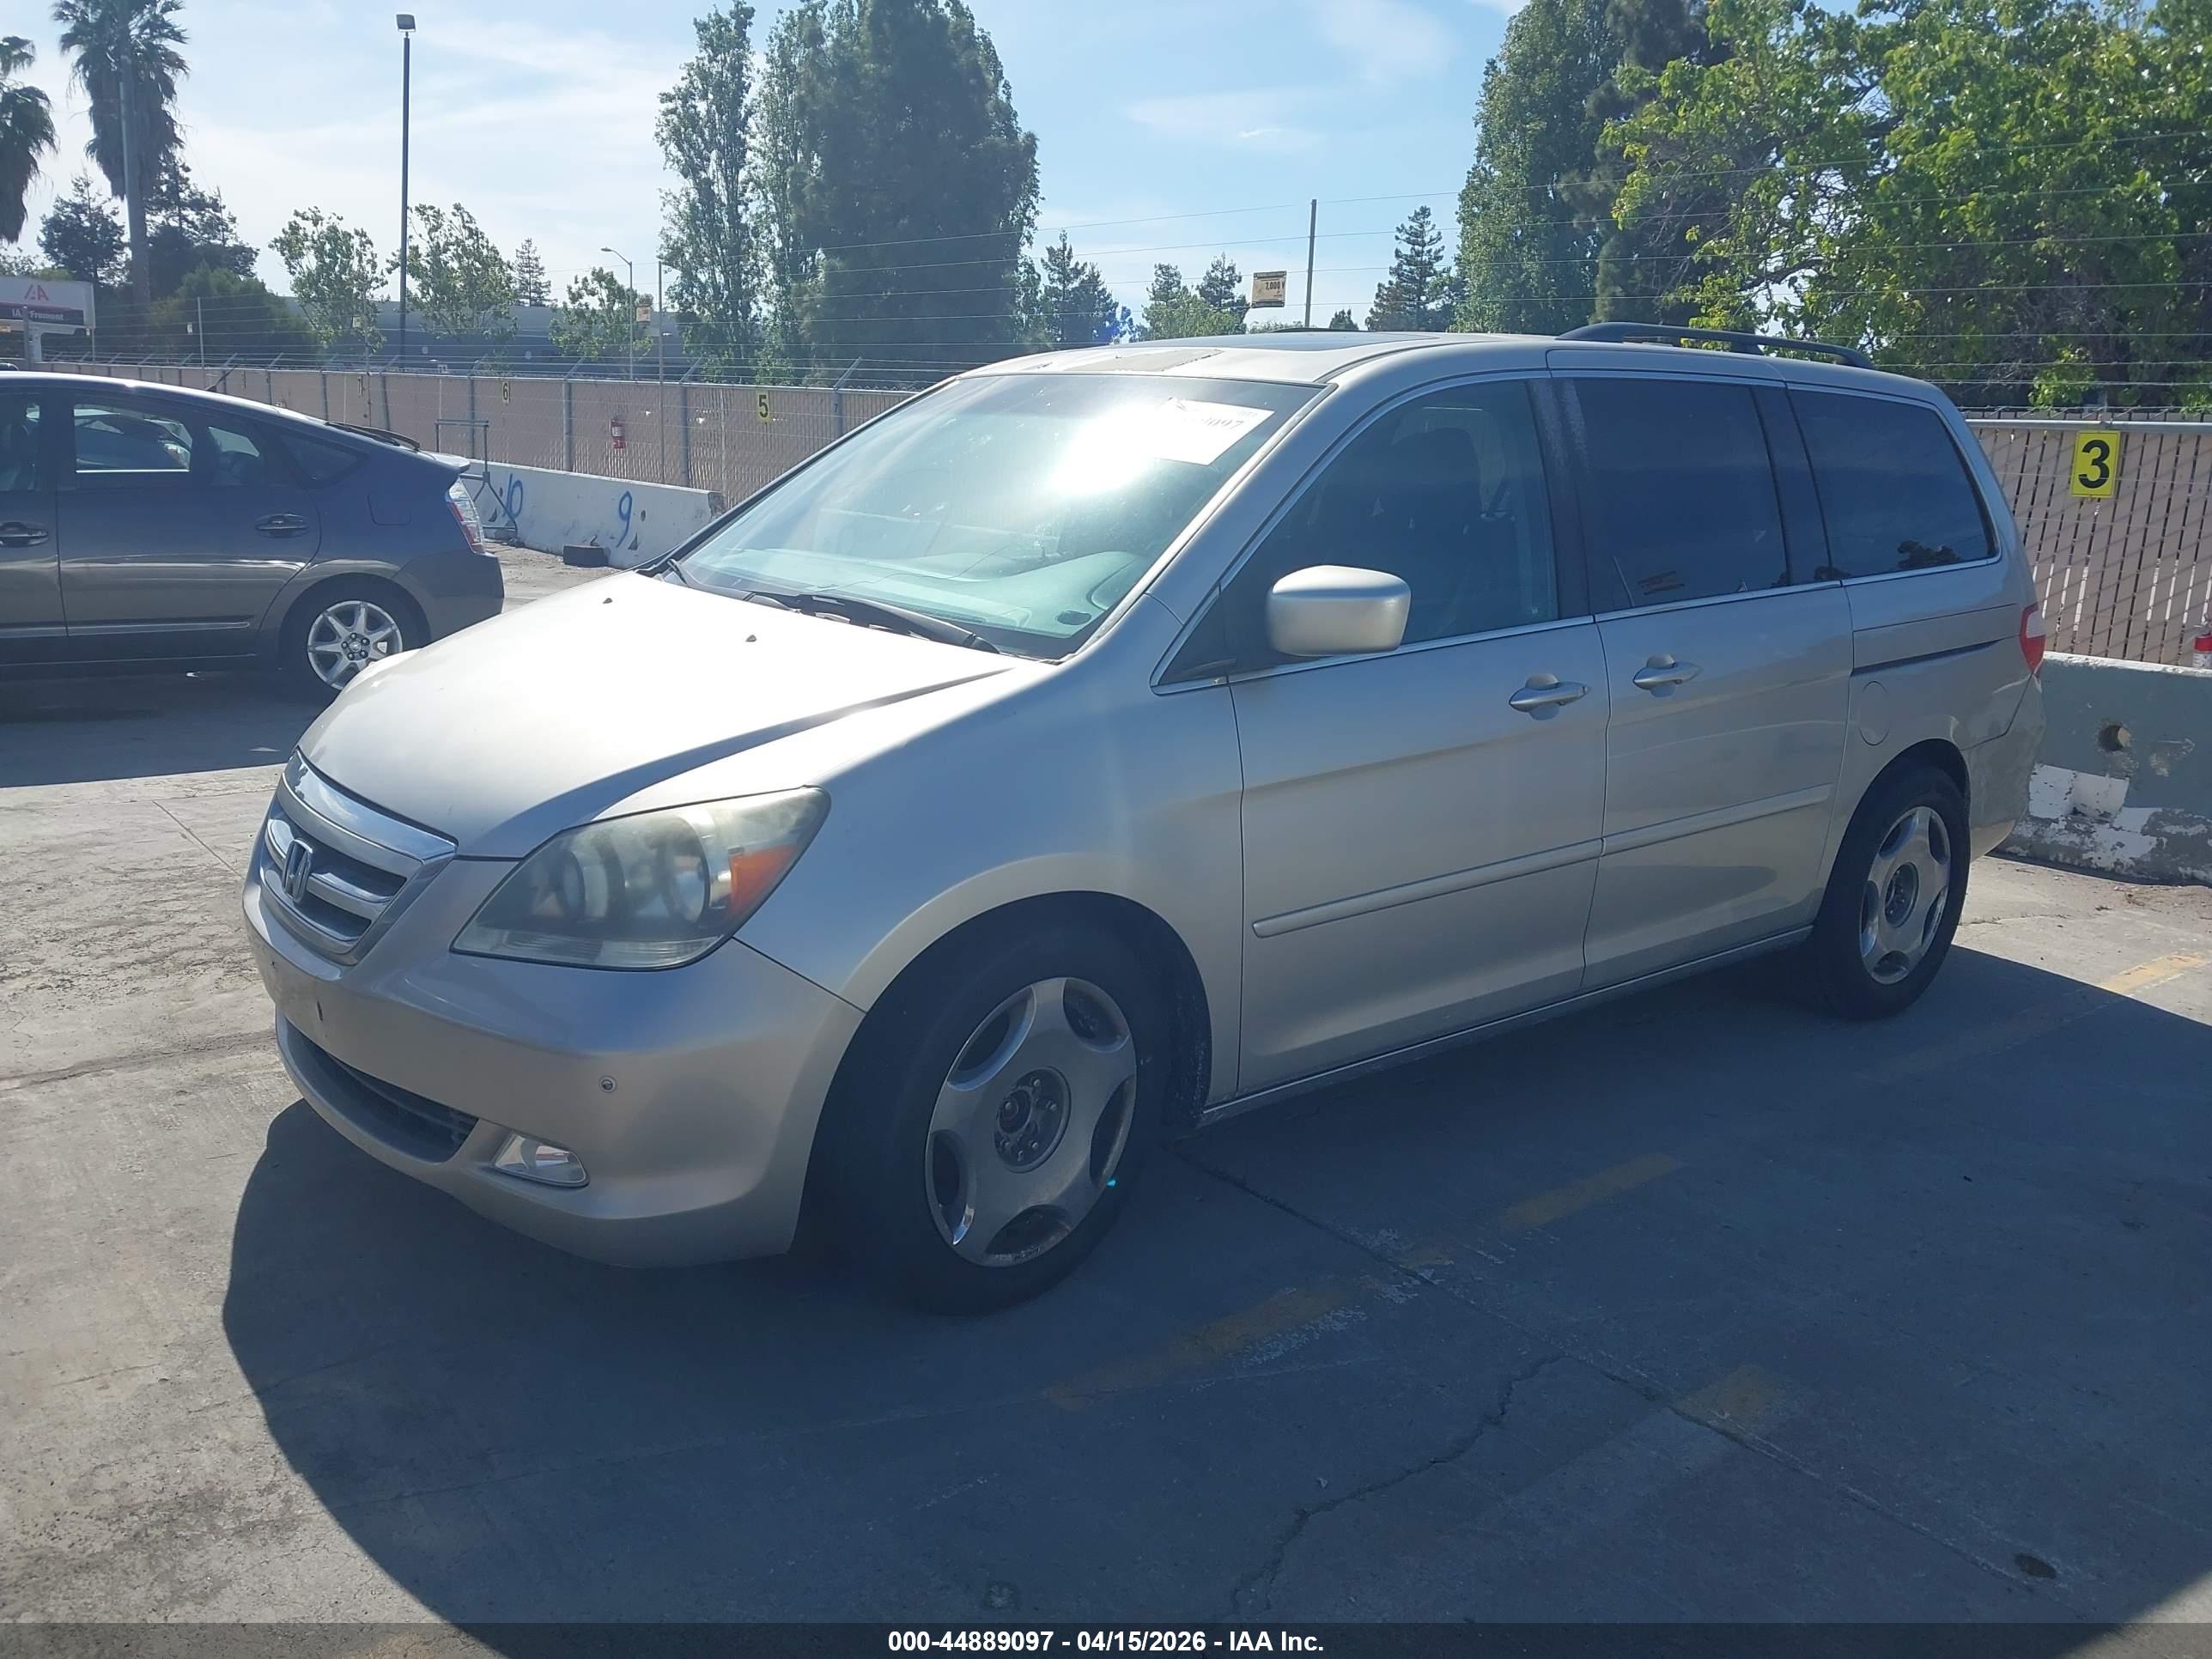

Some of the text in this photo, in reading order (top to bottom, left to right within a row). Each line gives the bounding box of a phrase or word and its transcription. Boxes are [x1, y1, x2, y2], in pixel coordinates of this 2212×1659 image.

[502, 382, 508, 401] 6
[758, 394, 769, 418] 5
[2078, 439, 2111, 489] 3
[616, 490, 633, 548] 9
